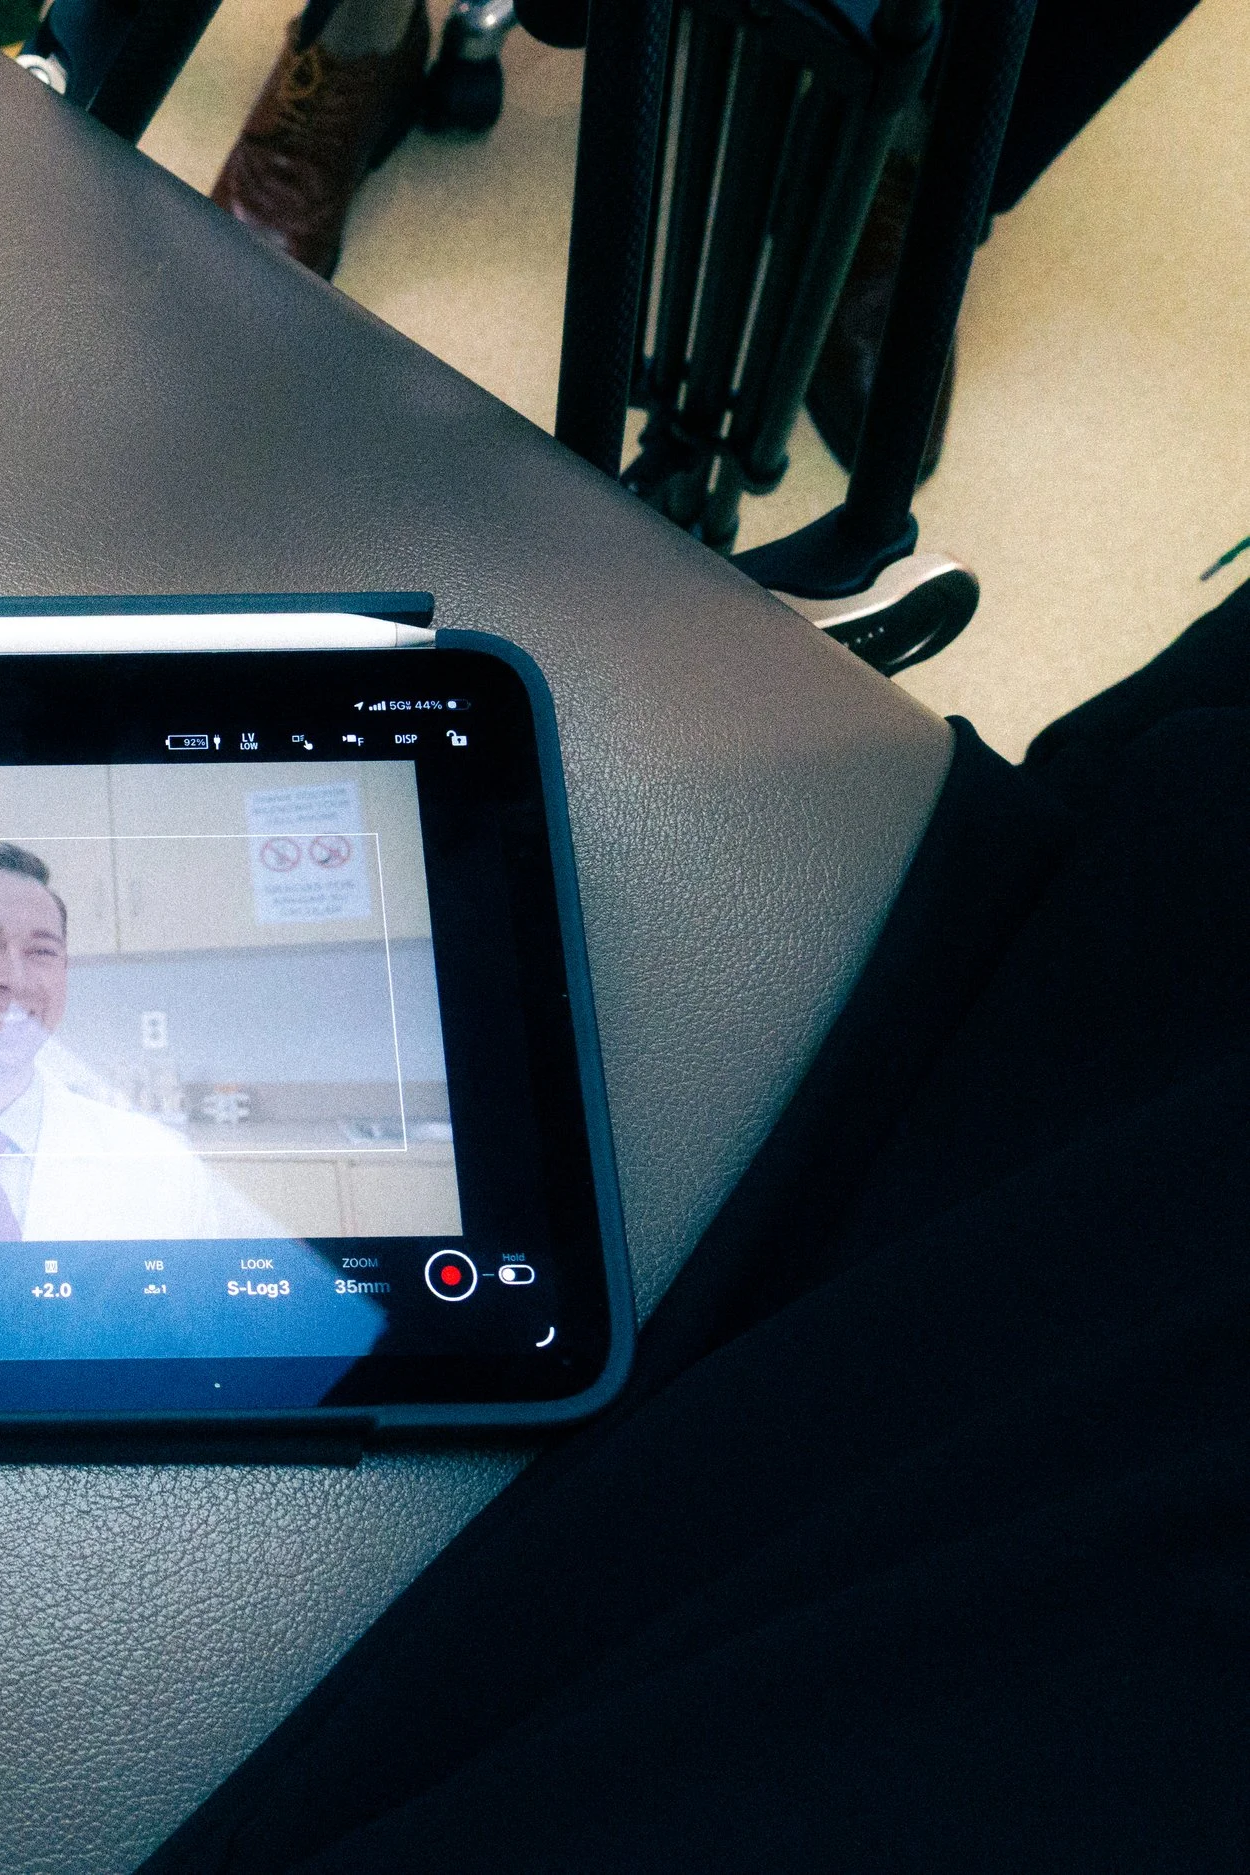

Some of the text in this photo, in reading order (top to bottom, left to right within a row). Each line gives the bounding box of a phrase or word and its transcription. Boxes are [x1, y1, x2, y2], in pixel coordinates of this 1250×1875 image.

[415, 700, 443, 710] 44%
[184, 738, 206, 747] 92%
[242, 733, 255, 742] LV
[395, 734, 418, 744] DISP
[240, 742, 258, 751] LOW
[502, 1253, 526, 1262] Hold
[144, 1260, 165, 1271] WB
[240, 1259, 274, 1270] LOOK
[342, 1257, 378, 1269] ZOOM
[31, 1282, 72, 1298] +2.0
[227, 1280, 291, 1297] S-Log3
[335, 1279, 391, 1295] 35mm
